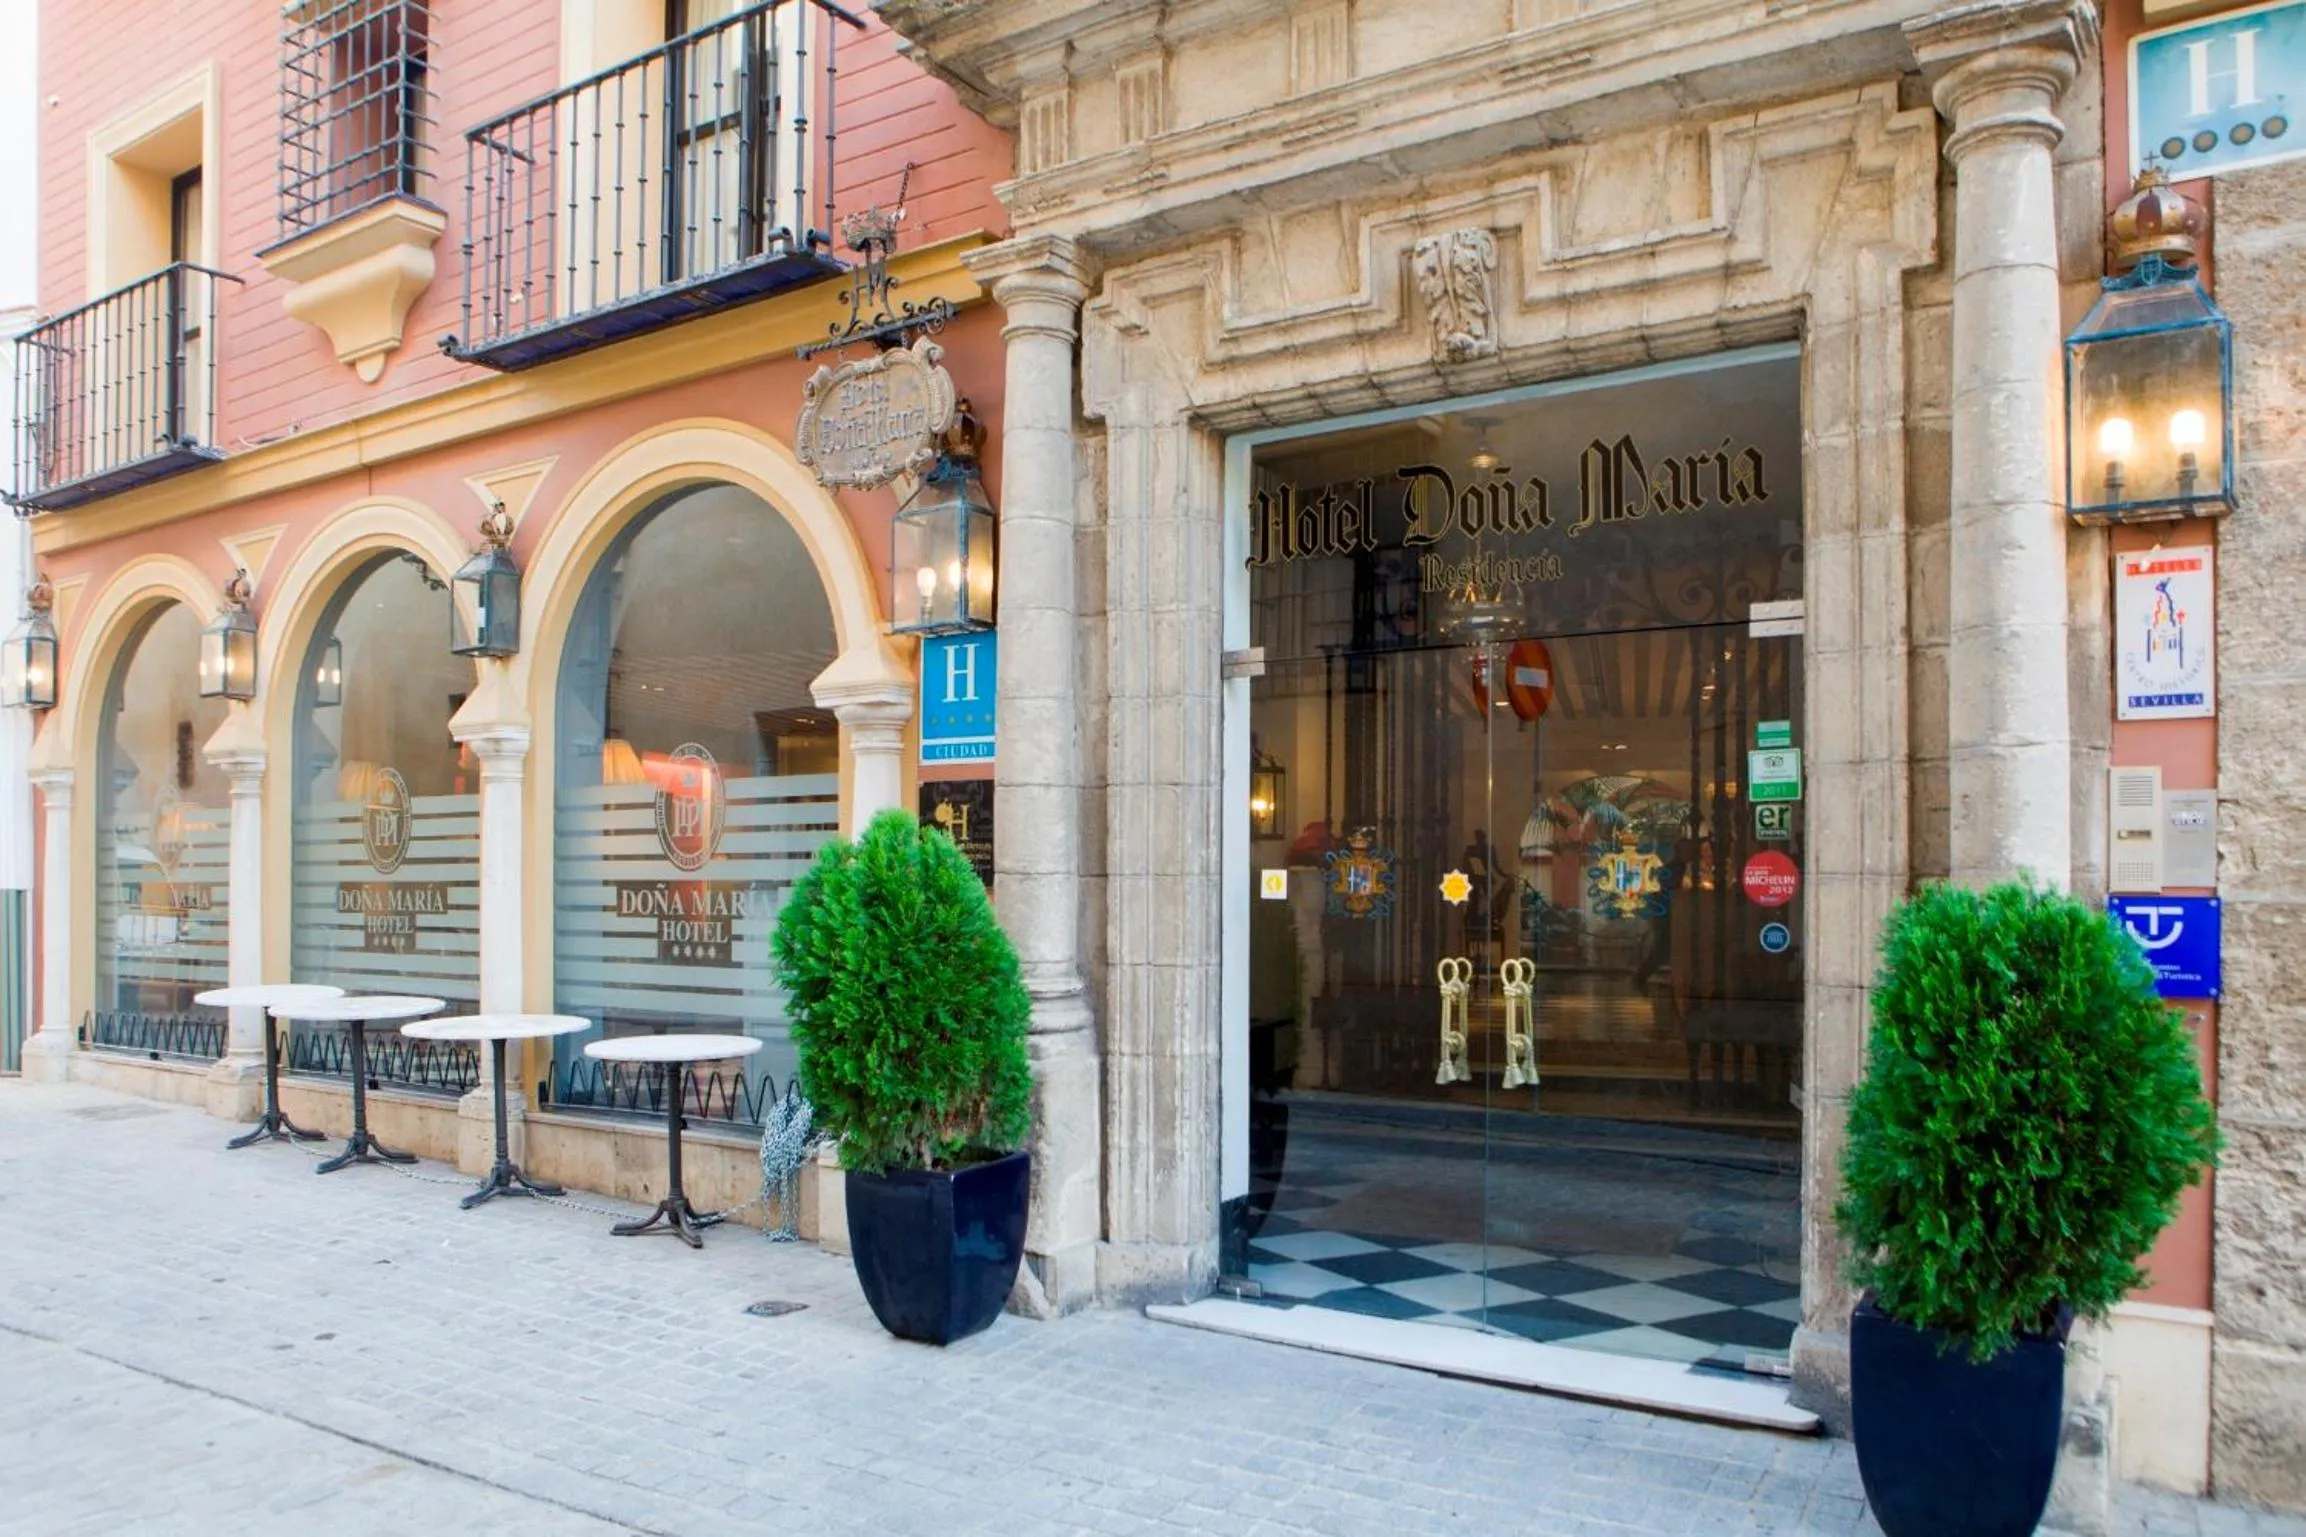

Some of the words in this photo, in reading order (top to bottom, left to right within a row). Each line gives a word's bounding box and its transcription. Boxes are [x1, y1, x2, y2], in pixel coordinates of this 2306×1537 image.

[2183, 28, 2262, 117] H
[1245, 475, 1379, 571] Hotel
[1397, 464, 1556, 547] Doña
[1567, 433, 1769, 538] María
[1419, 549, 1564, 593] Residencia
[942, 643, 980, 703] H
[2128, 694, 2204, 708] SEVILLA
[935, 743, 988, 758] CIUDAD
[1758, 807, 1790, 828] er
[339, 885, 383, 911] DOÑA
[388, 883, 444, 912] MARÍA
[620, 883, 684, 915] DOÑA
[692, 883, 772, 916] MARÍA
[366, 915, 414, 934] HOTEL
[662, 920, 728, 942] HOTEL
